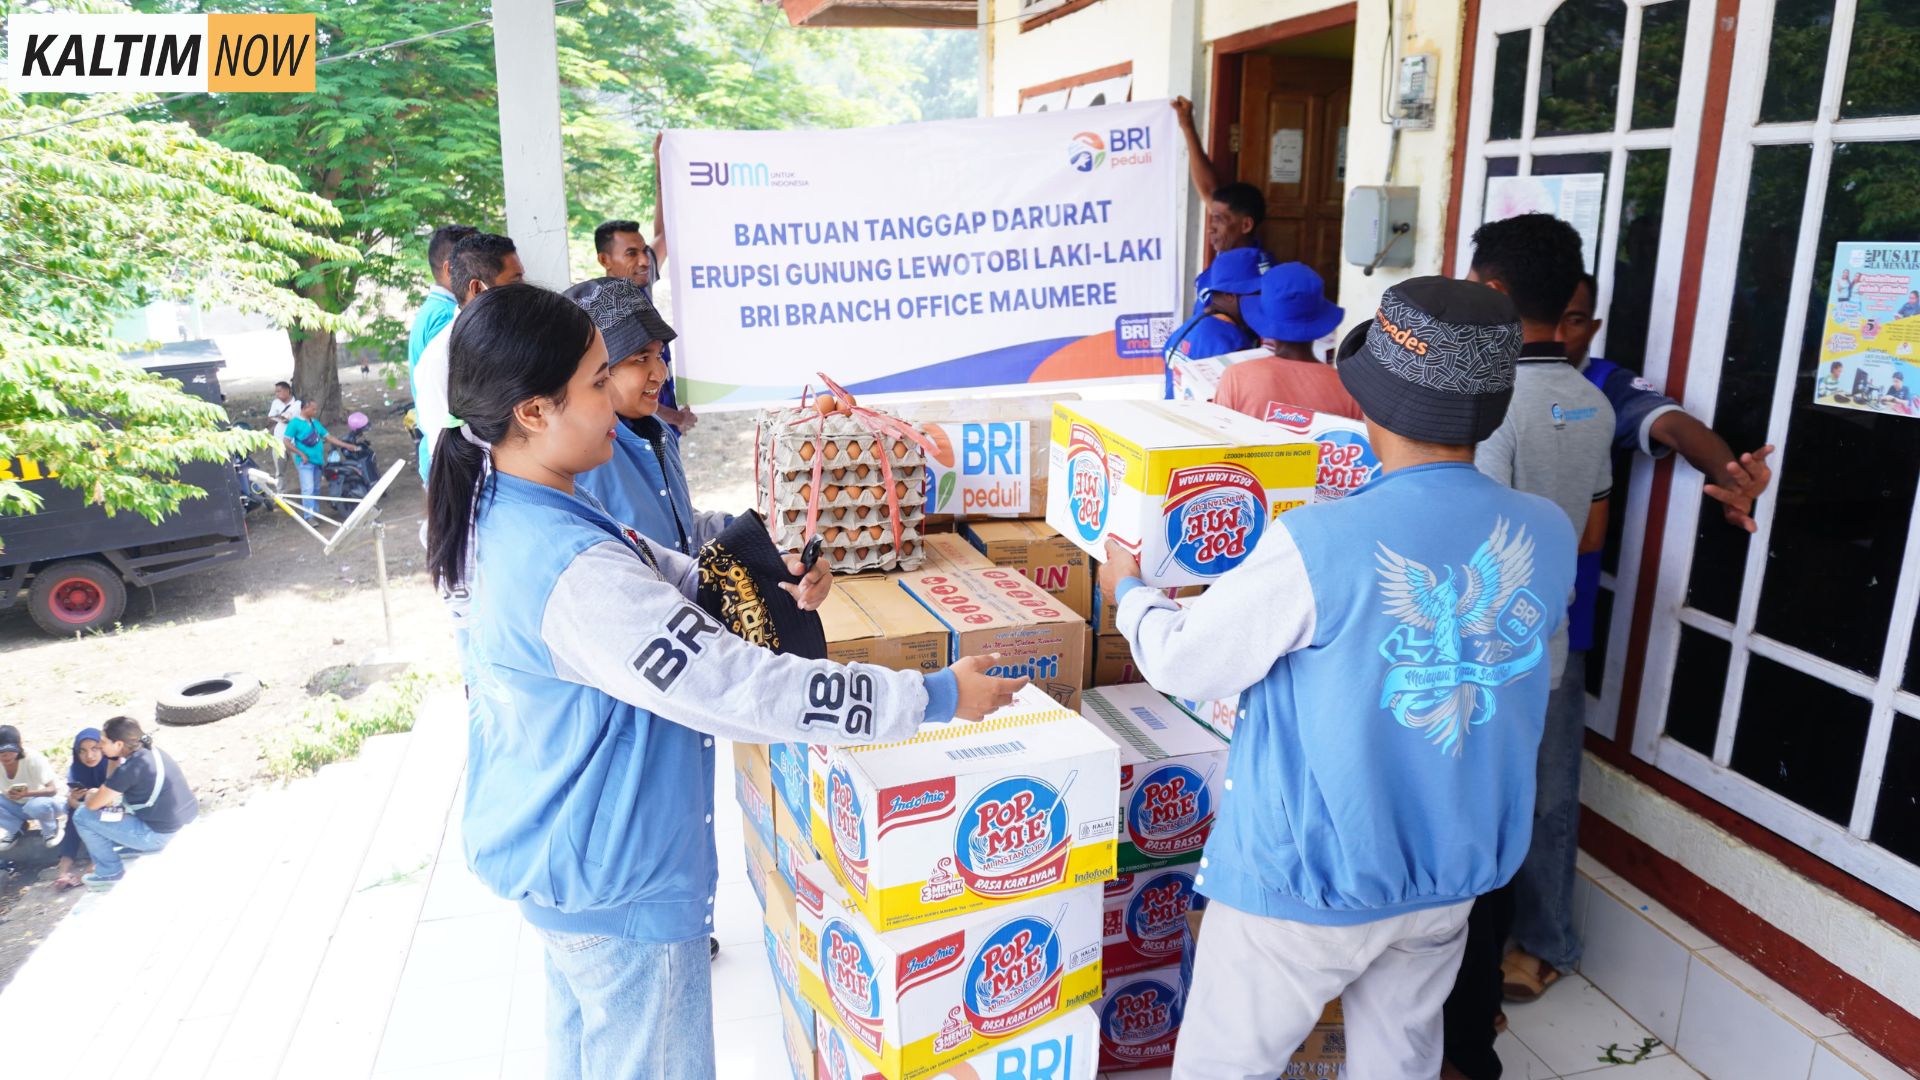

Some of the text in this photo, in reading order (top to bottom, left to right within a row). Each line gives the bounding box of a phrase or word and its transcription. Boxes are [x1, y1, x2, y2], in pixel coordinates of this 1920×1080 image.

[1109, 126, 1151, 152] BRI
[1110, 152, 1152, 168] peduli
[734, 200, 1112, 247] BANTUAN TANGGAP DARURAT
[690, 237, 1162, 289] ERUPSI GUNUNG LEWOTOBI LAKI-LAKI
[1872, 250, 1920, 263] PUSAT
[740, 281, 1117, 328] BRI BRANCH OFFICE MAUMERE
[1121, 324, 1149, 340] BRI
[962, 422, 1022, 476] BRI
[1317, 442, 1362, 467] POP
[1075, 472, 1099, 498] MIE
[1178, 471, 1254, 487] RASA KARI AYAM
[1316, 465, 1367, 488] MIE
[962, 481, 1022, 513] peduli
[1079, 498, 1100, 527] POP
[1185, 507, 1241, 544] MIE
[1198, 526, 1247, 563] POP
[1507, 618, 1528, 637] mo
[1511, 598, 1541, 628] BRI
[833, 776, 852, 811] POP
[1144, 776, 1185, 811] POP
[1151, 792, 1195, 825] MIE
[835, 807, 858, 841] MIE
[976, 789, 1034, 837] POP
[1092, 820, 1113, 830] HALAL
[987, 811, 1046, 858] MIE
[1144, 834, 1202, 850] RASA BASO
[993, 850, 1025, 868] INSTAN
[1025, 842, 1044, 857] CUP
[975, 866, 1057, 891] RASA KARI AYAM
[1074, 865, 1113, 884] Indofood
[921, 880, 964, 903] 3 MENIT
[1142, 881, 1181, 912] POP
[1149, 896, 1188, 926] MIE
[831, 932, 860, 969] POP
[982, 929, 1031, 982] POP
[1140, 940, 1166, 950] RASA
[837, 962, 868, 1001] MIE
[990, 945, 1042, 1000] MIE
[1066, 986, 1099, 1009] Indofood
[1116, 990, 1158, 1018] POP
[980, 998, 1052, 1032] RASA KARI AYAM
[1123, 1003, 1167, 1033] MIE
[1115, 1043, 1171, 1056] RASA AYAM
